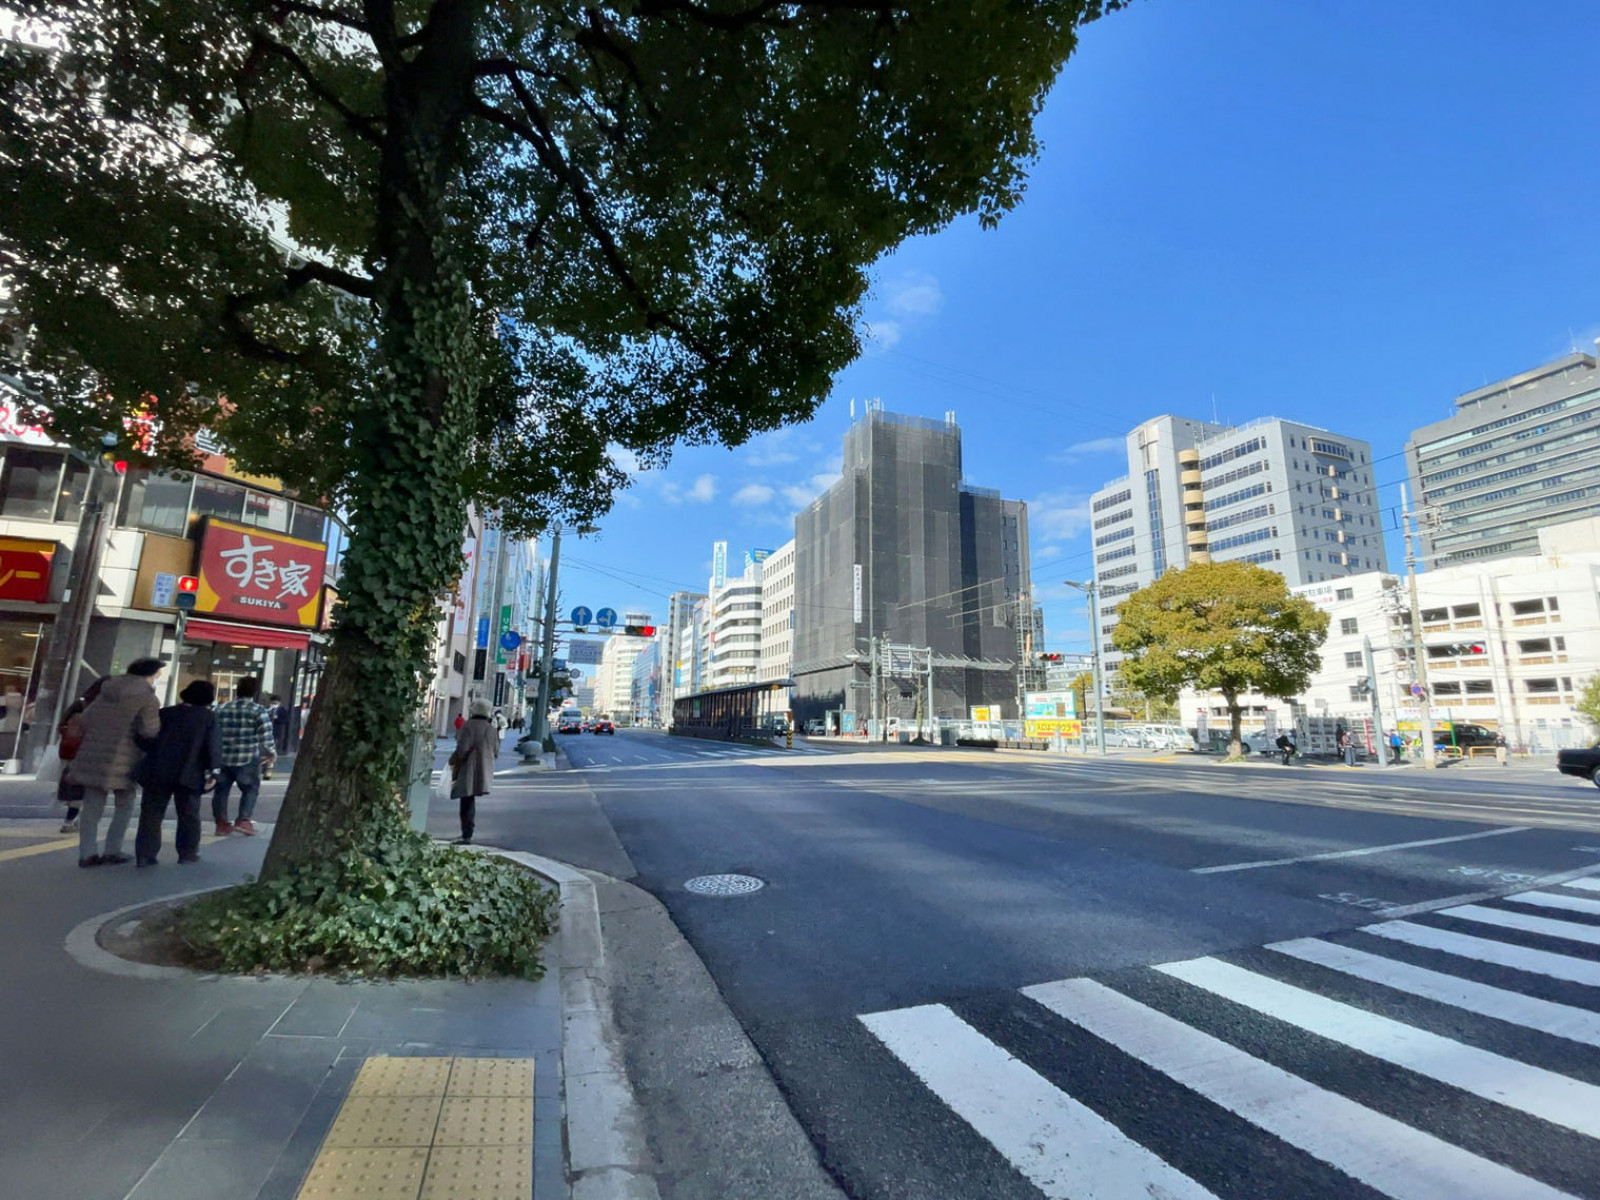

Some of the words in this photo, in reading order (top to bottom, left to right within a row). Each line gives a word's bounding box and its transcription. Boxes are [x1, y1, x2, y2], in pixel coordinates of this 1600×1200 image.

[220, 535, 311, 600] すき家
[240, 597, 281, 610] SUKIYA
